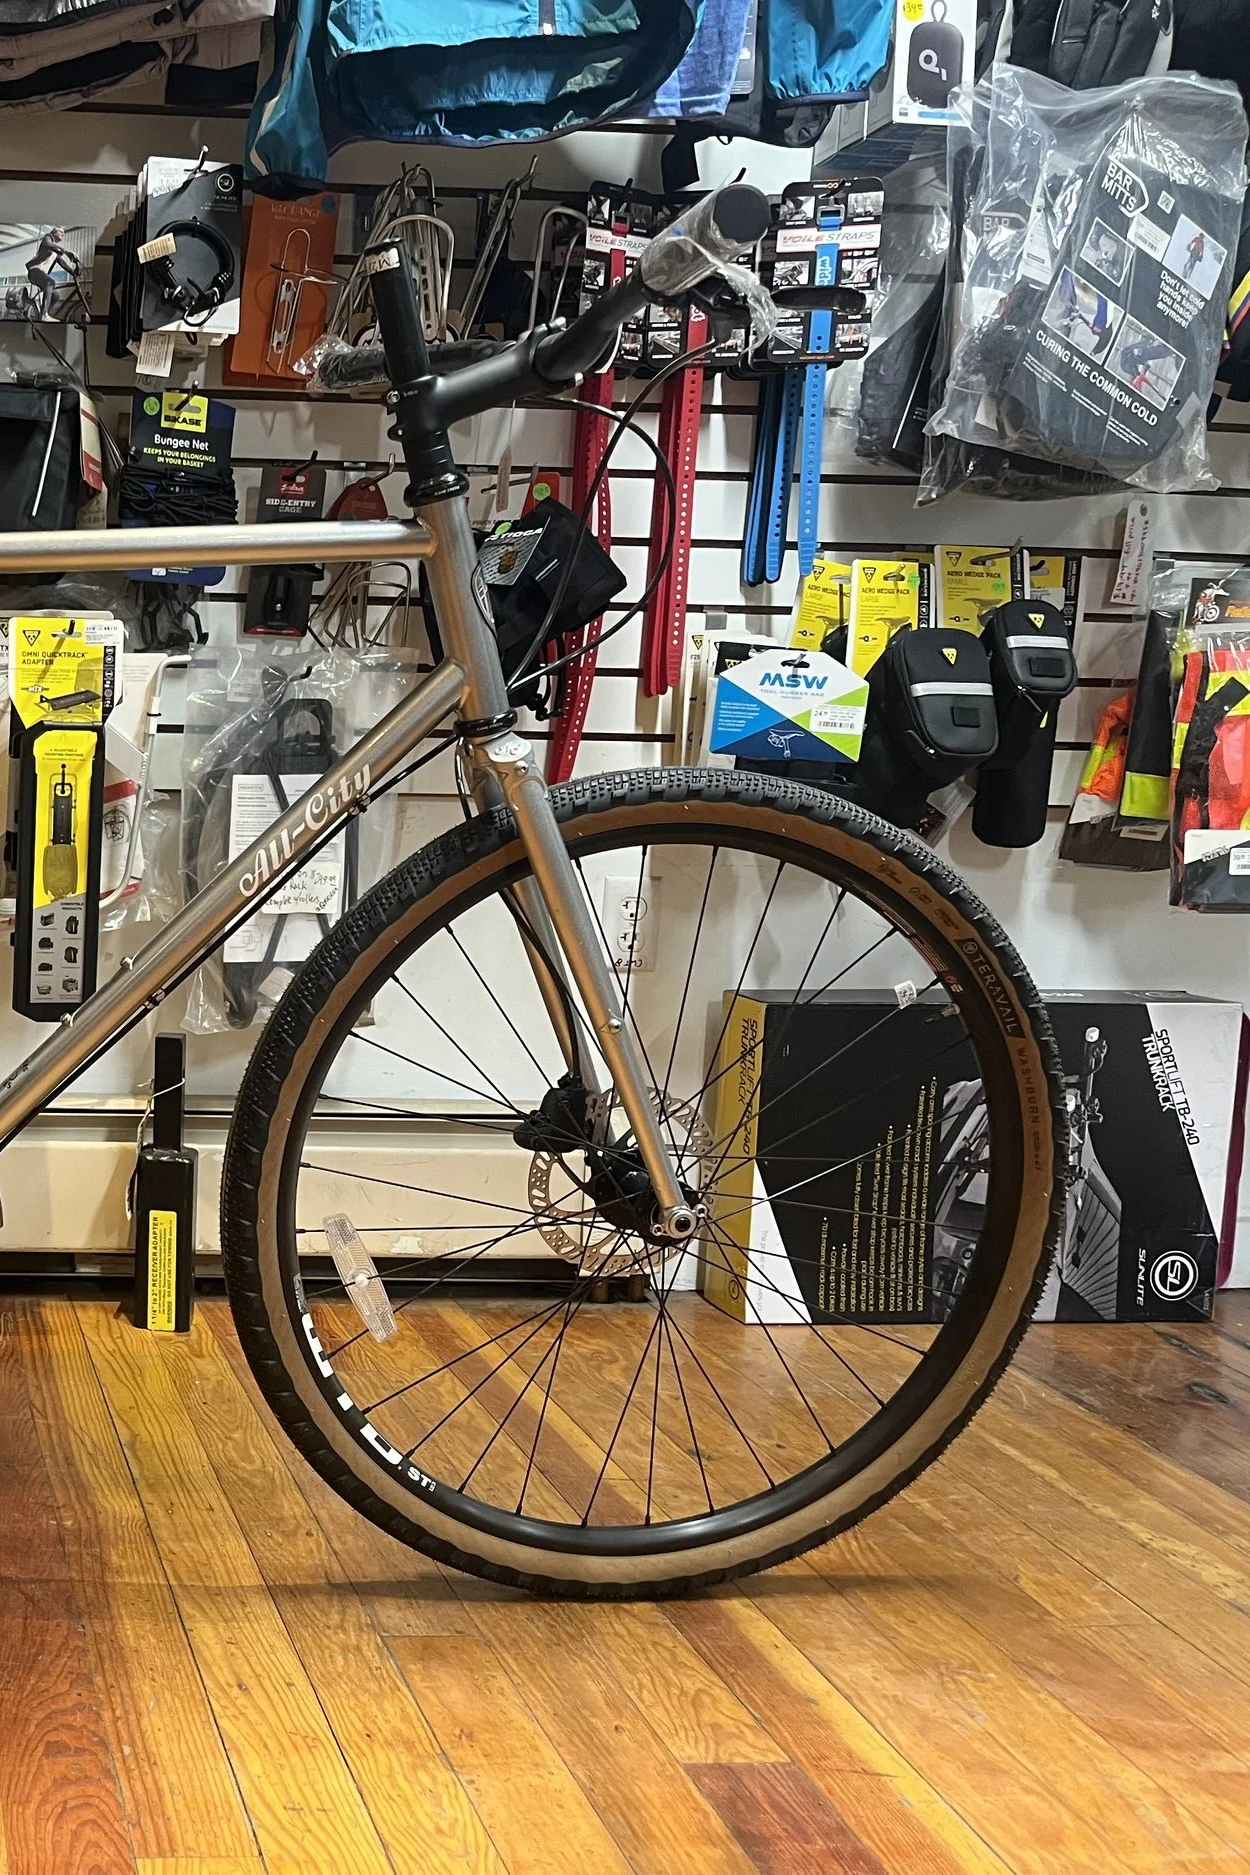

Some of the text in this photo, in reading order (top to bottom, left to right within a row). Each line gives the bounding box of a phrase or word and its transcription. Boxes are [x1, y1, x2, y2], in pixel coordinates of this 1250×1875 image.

[1105, 161, 1136, 188] BAR
[1101, 177, 1138, 212] MITTS
[826, 231, 878, 241] STRAPS
[1036, 331, 1071, 364] CURING
[1070, 357, 1090, 378] THE
[1088, 366, 1133, 407] COMMON
[1131, 399, 1158, 427] COLD
[143, 447, 216, 463] KEEPS YOUR BELONGINGS
[154, 434, 209, 451] Bungee Net
[182, 459, 204, 468] BASKET
[265, 498, 317, 507] SIDE-ENTRY
[947, 570, 962, 578] AERO
[759, 673, 829, 690] MSW
[239, 763, 372, 898] All-City
[972, 953, 1020, 1034] TERAVAIL
[1016, 1046, 1041, 1128] WASHBURN
[1141, 1035, 1176, 1112] TRUNKRACK
[1154, 1028, 1200, 1146] SPORTLIFT TB-240
[1136, 1248, 1146, 1306] SUNLITE
